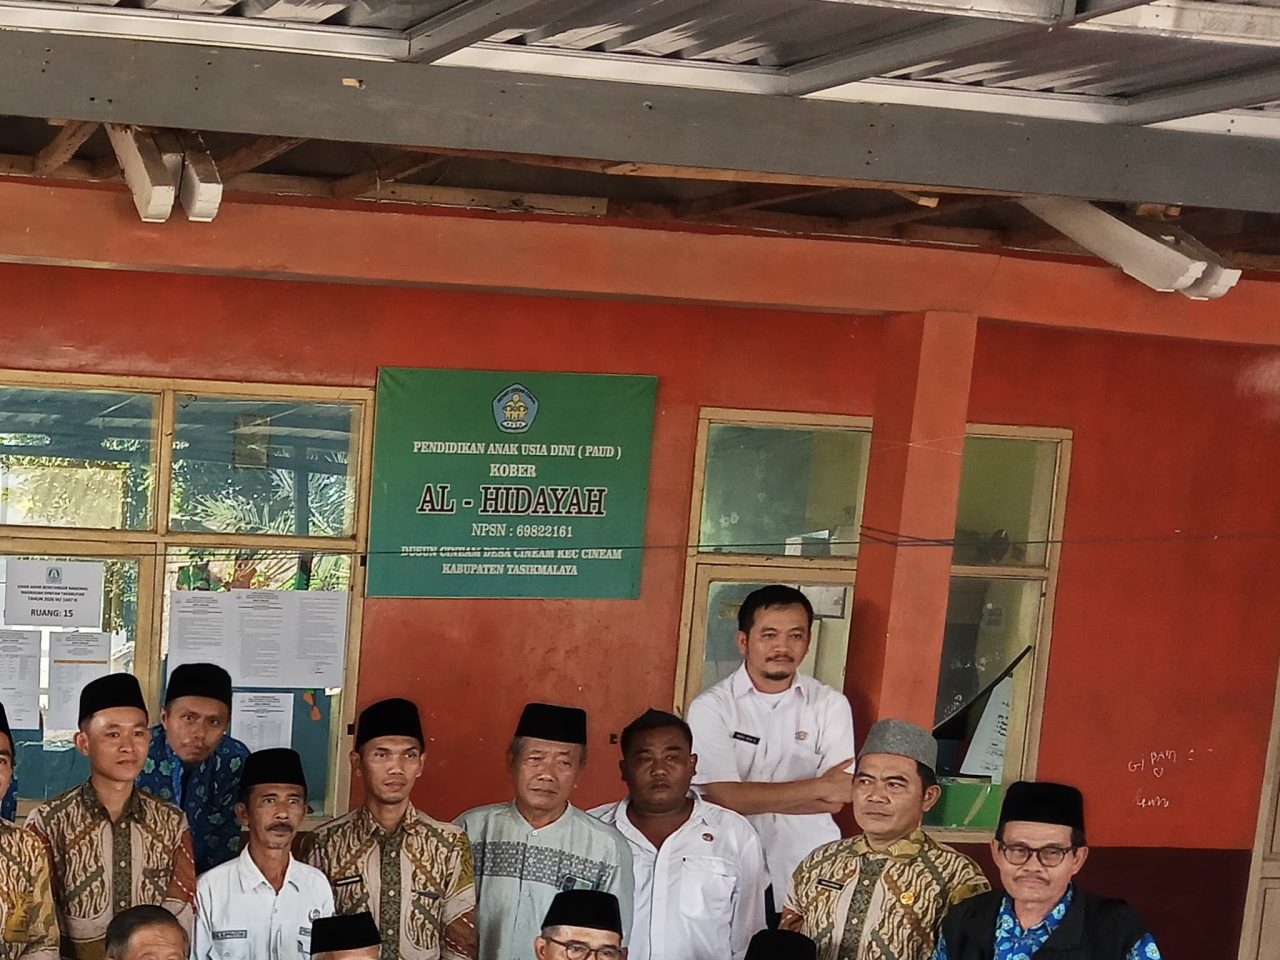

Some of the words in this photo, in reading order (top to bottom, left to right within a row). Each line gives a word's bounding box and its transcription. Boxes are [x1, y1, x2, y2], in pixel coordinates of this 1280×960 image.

[413, 441, 486, 454] PENDIDIKAN
[487, 443, 519, 454] ANAK
[521, 444, 548, 456] USIA
[550, 445, 576, 456] DINI
[585, 446, 614, 458] PAUD
[489, 464, 536, 478] KOBER
[416, 483, 456, 514] AL
[478, 484, 608, 516] HIDAYAH
[472, 523, 508, 536] NPSN
[516, 525, 573, 538] 69822161
[400, 546, 438, 556] DUSUN
[440, 546, 480, 557] CINEAM
[483, 546, 512, 558] DESA
[514, 548, 555, 558] CINEAM
[557, 549, 579, 558] KEC
[581, 549, 622, 560] CINEAM
[442, 563, 504, 574] KABUPATEN
[506, 564, 578, 575] TASIKMALAYA
[30, 608, 61, 617] RUANG:
[64, 609, 74, 618] 15
